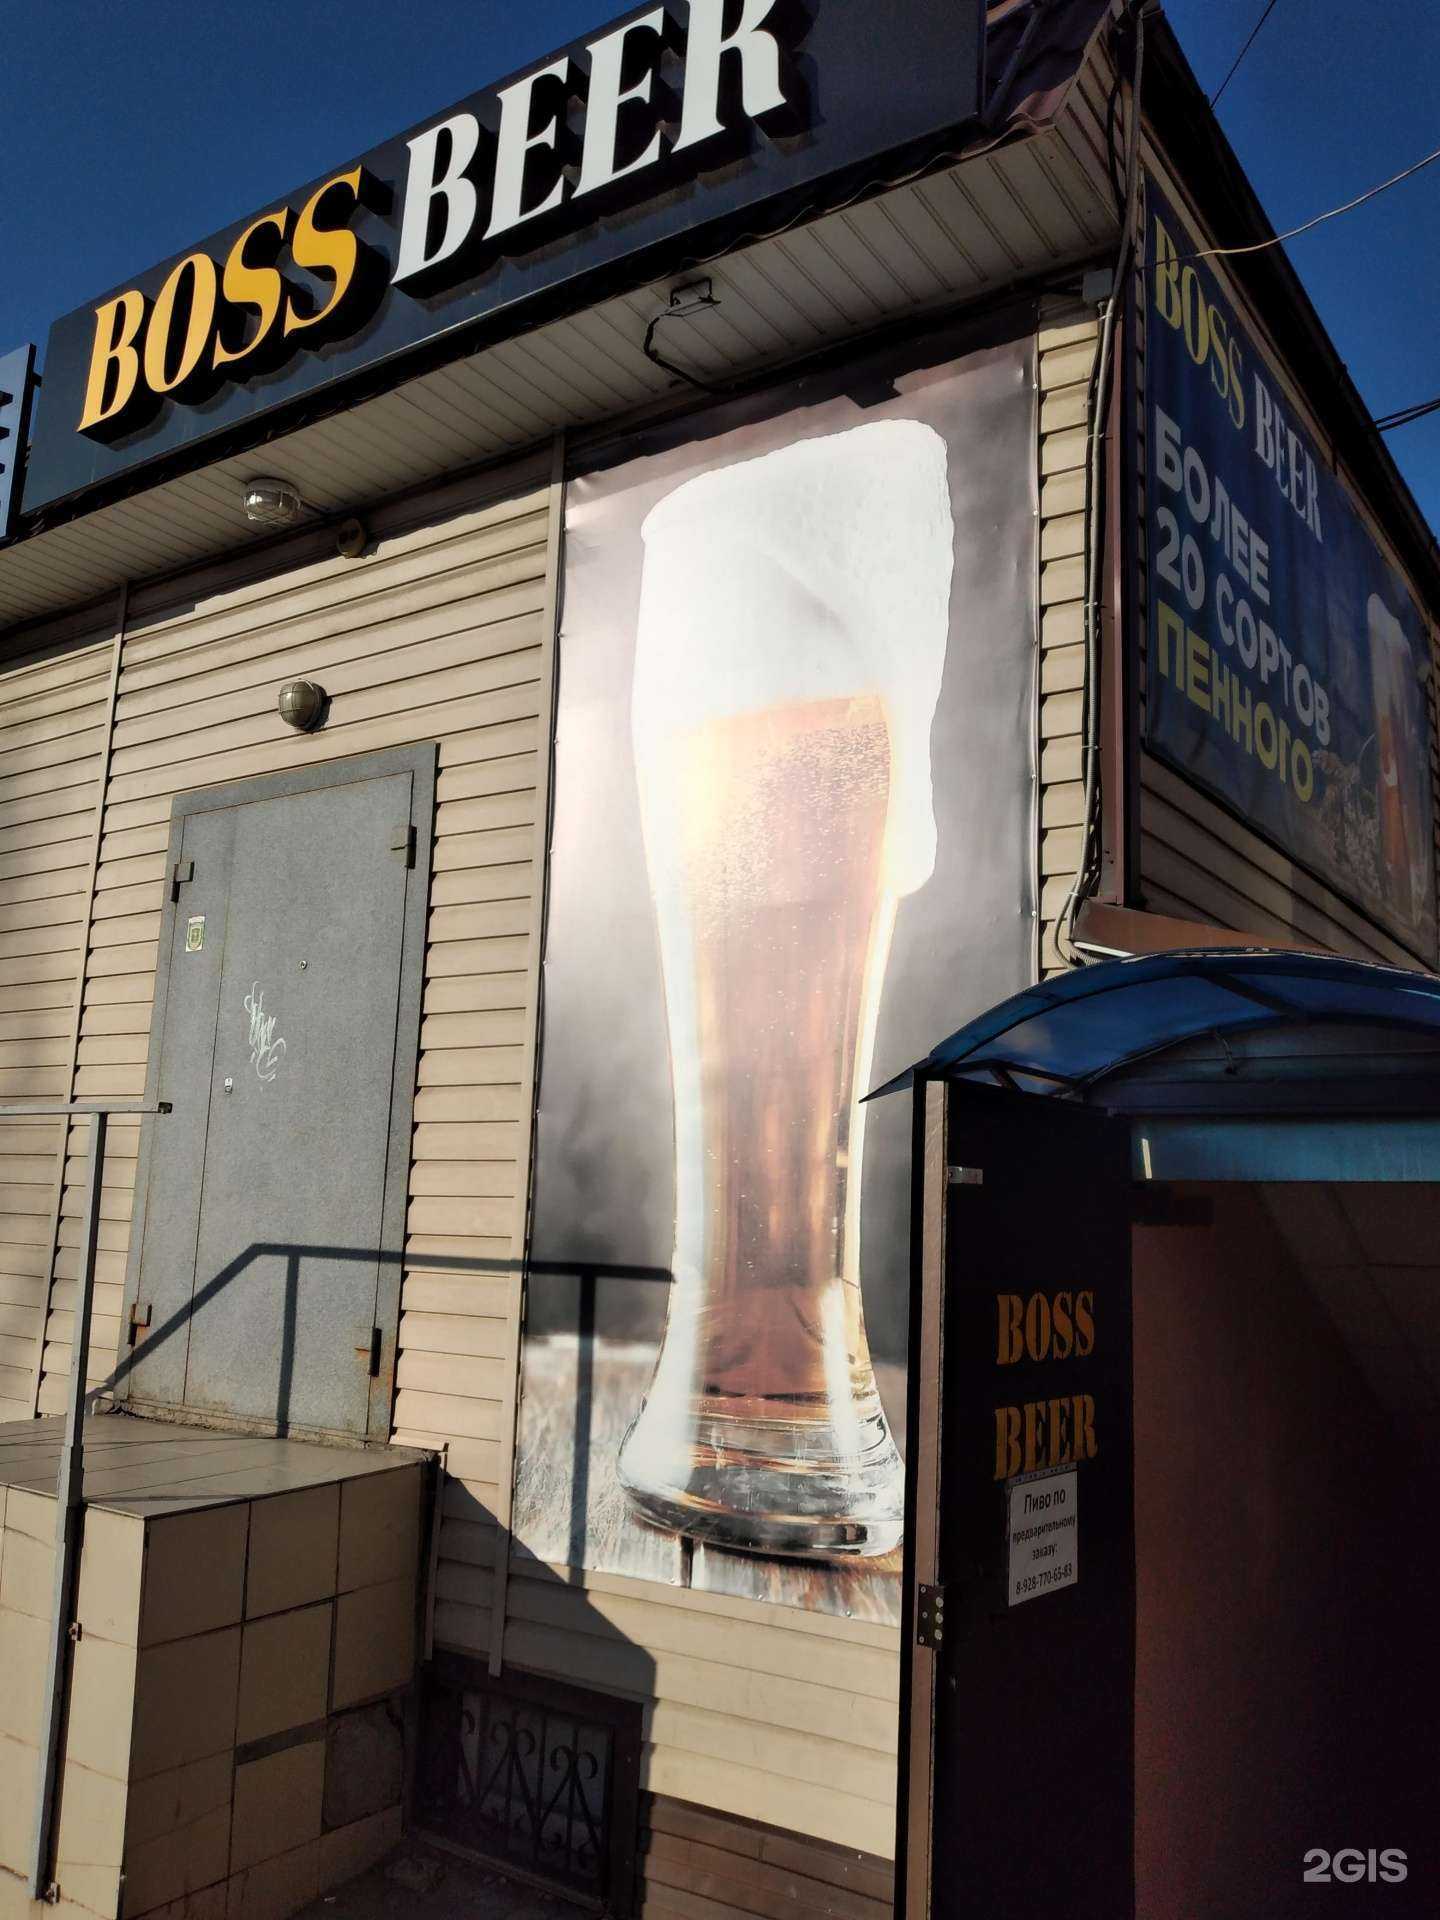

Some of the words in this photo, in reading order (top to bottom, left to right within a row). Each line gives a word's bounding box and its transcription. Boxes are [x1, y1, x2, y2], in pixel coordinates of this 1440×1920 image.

[77, 164, 363, 433] BOSS
[390, 0, 787, 284] BEER
[1153, 213, 1245, 432] BOSS
[1253, 371, 1324, 545] BEER
[1155, 404, 1270, 606] БОЛЕЕ
[1156, 506, 1205, 612] 20
[1216, 572, 1332, 746] СОРТОВ
[1156, 600, 1315, 804] ПЕННОГО
[996, 1291, 1095, 1365] BOSS
[993, 1394, 1098, 1479] BEER
[1023, 1492, 1051, 1515] Пиво
[1053, 1488, 1066, 1505] по
[1012, 1515, 1077, 1546] предварительному
[1031, 1543, 1059, 1562] заказу:
